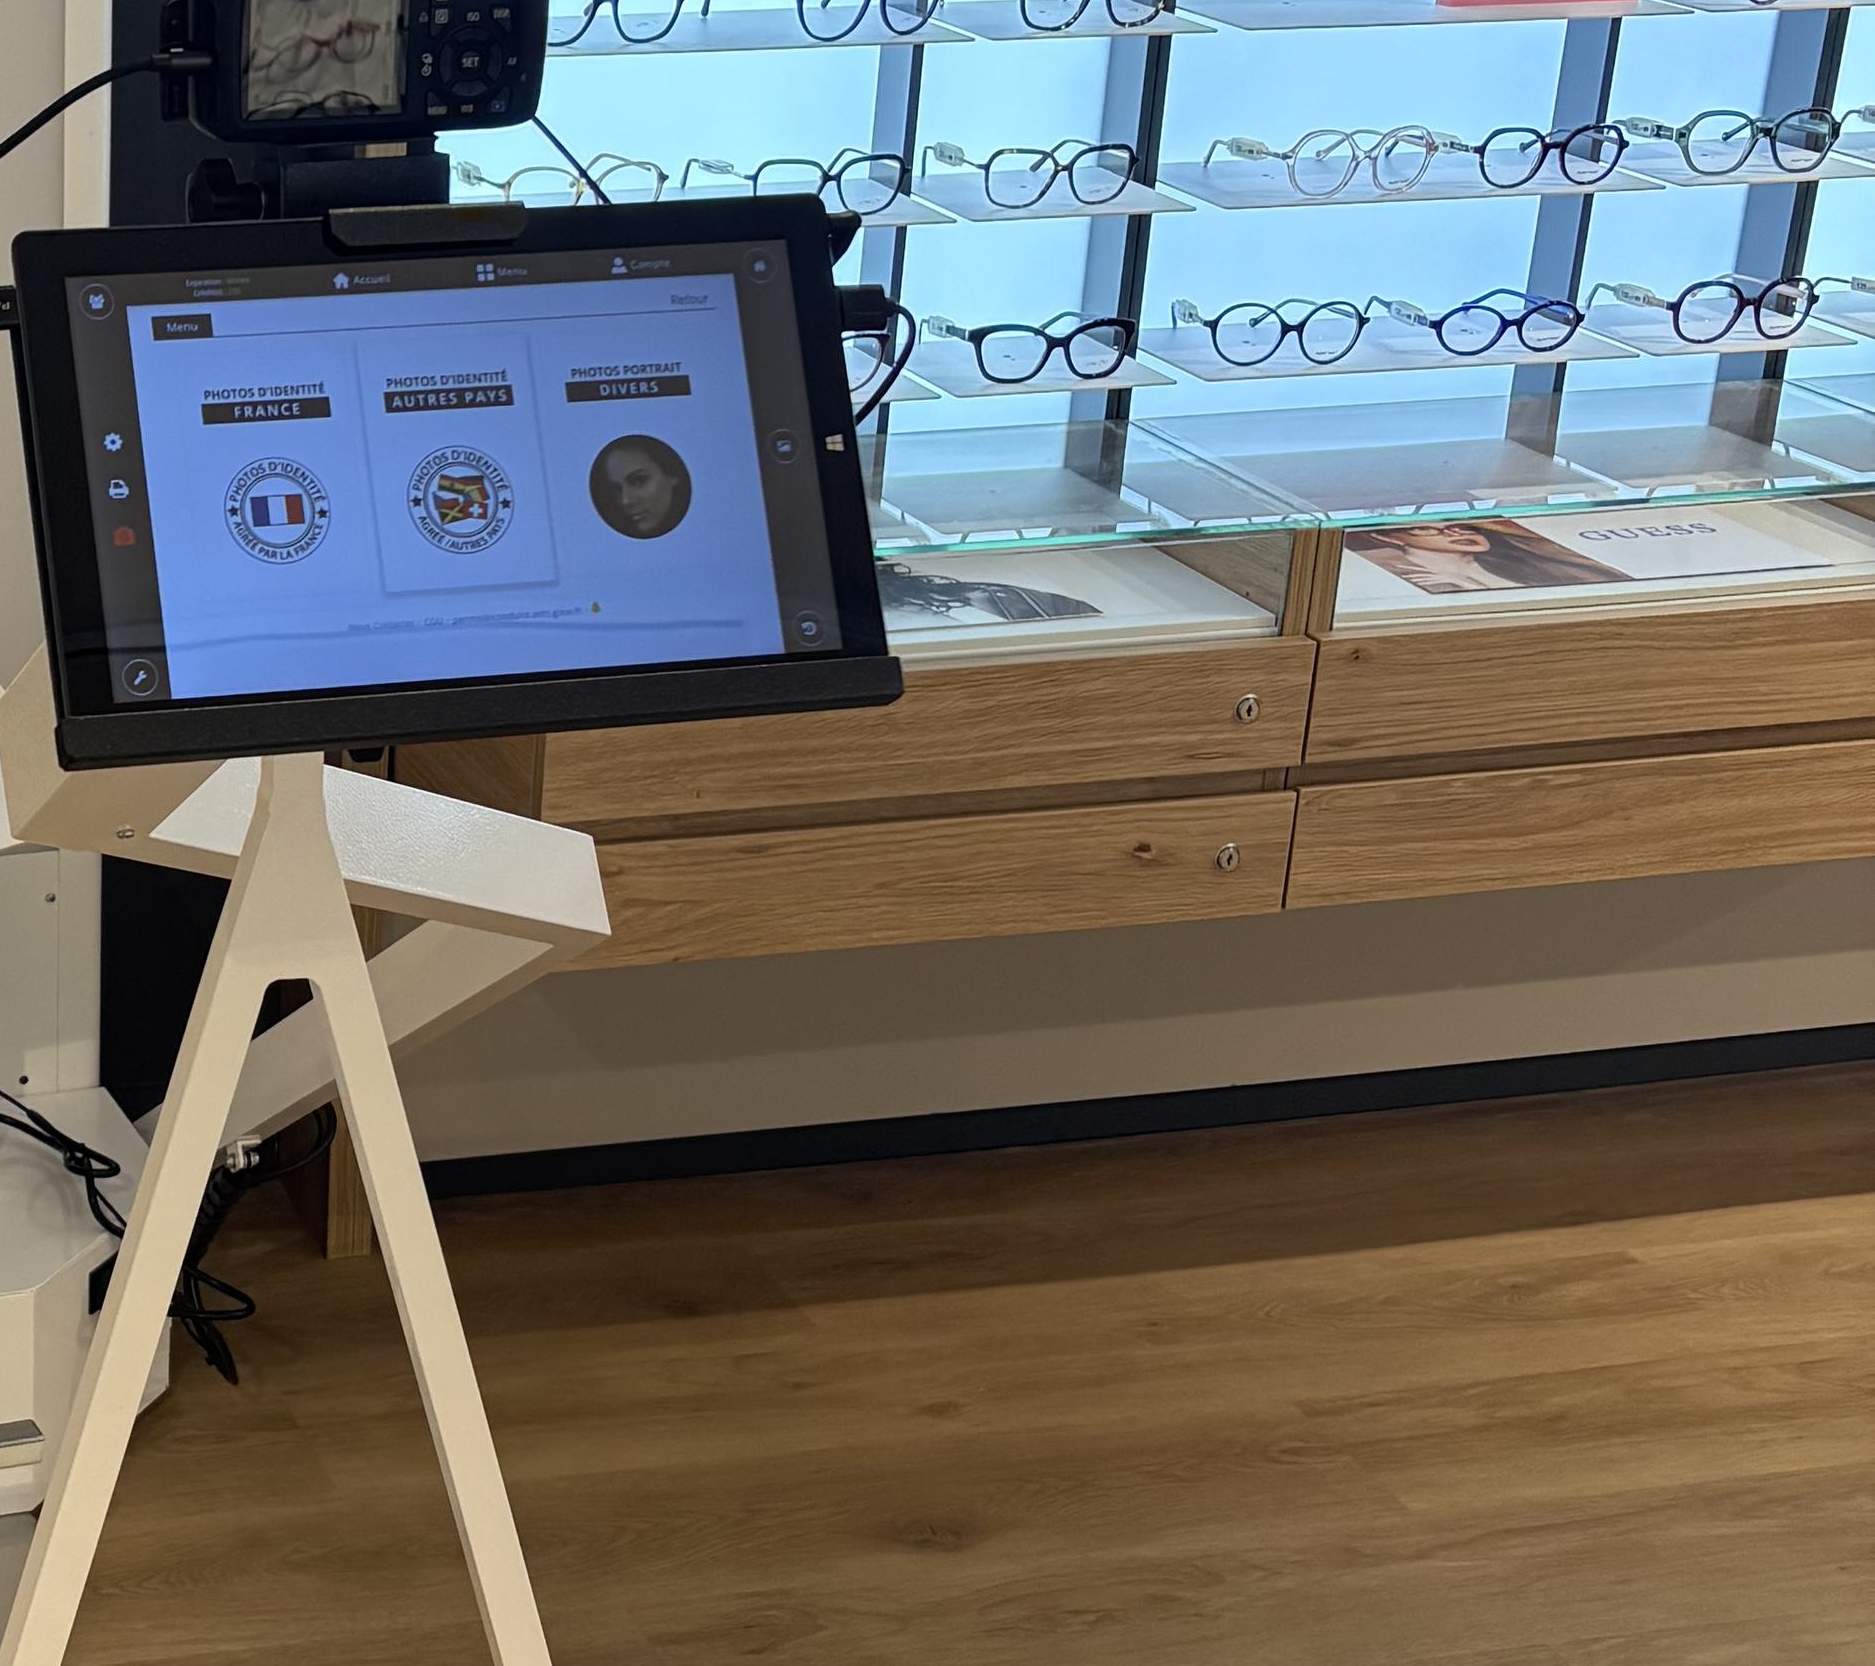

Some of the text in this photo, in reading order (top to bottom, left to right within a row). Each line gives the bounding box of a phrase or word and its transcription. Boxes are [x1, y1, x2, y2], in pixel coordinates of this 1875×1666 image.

[461, 57, 480, 68] SET
[497, 267, 528, 277] Menu
[630, 259, 671, 271] Compte
[352, 273, 391, 285] Accueil
[669, 294, 709, 305] Retour
[166, 322, 199, 333] Menu
[386, 368, 508, 389] PHOTOS D'IDENTITÉ
[570, 362, 682, 379] PHOTOS PORTRAIT
[204, 381, 326, 402] PHOTOS D'IDENTITÉ
[599, 381, 659, 396] DIVERS
[392, 388, 507, 408] AUTRES PAYS
[234, 402, 302, 419] FRANCE
[411, 451, 450, 493] PHOTOS
[229, 462, 266, 503] PHOTOS
[1578, 522, 1717, 541] GUESS
[257, 546, 278, 560] PAR
[279, 549, 294, 561] LA
[292, 523, 324, 557] FRANCE
